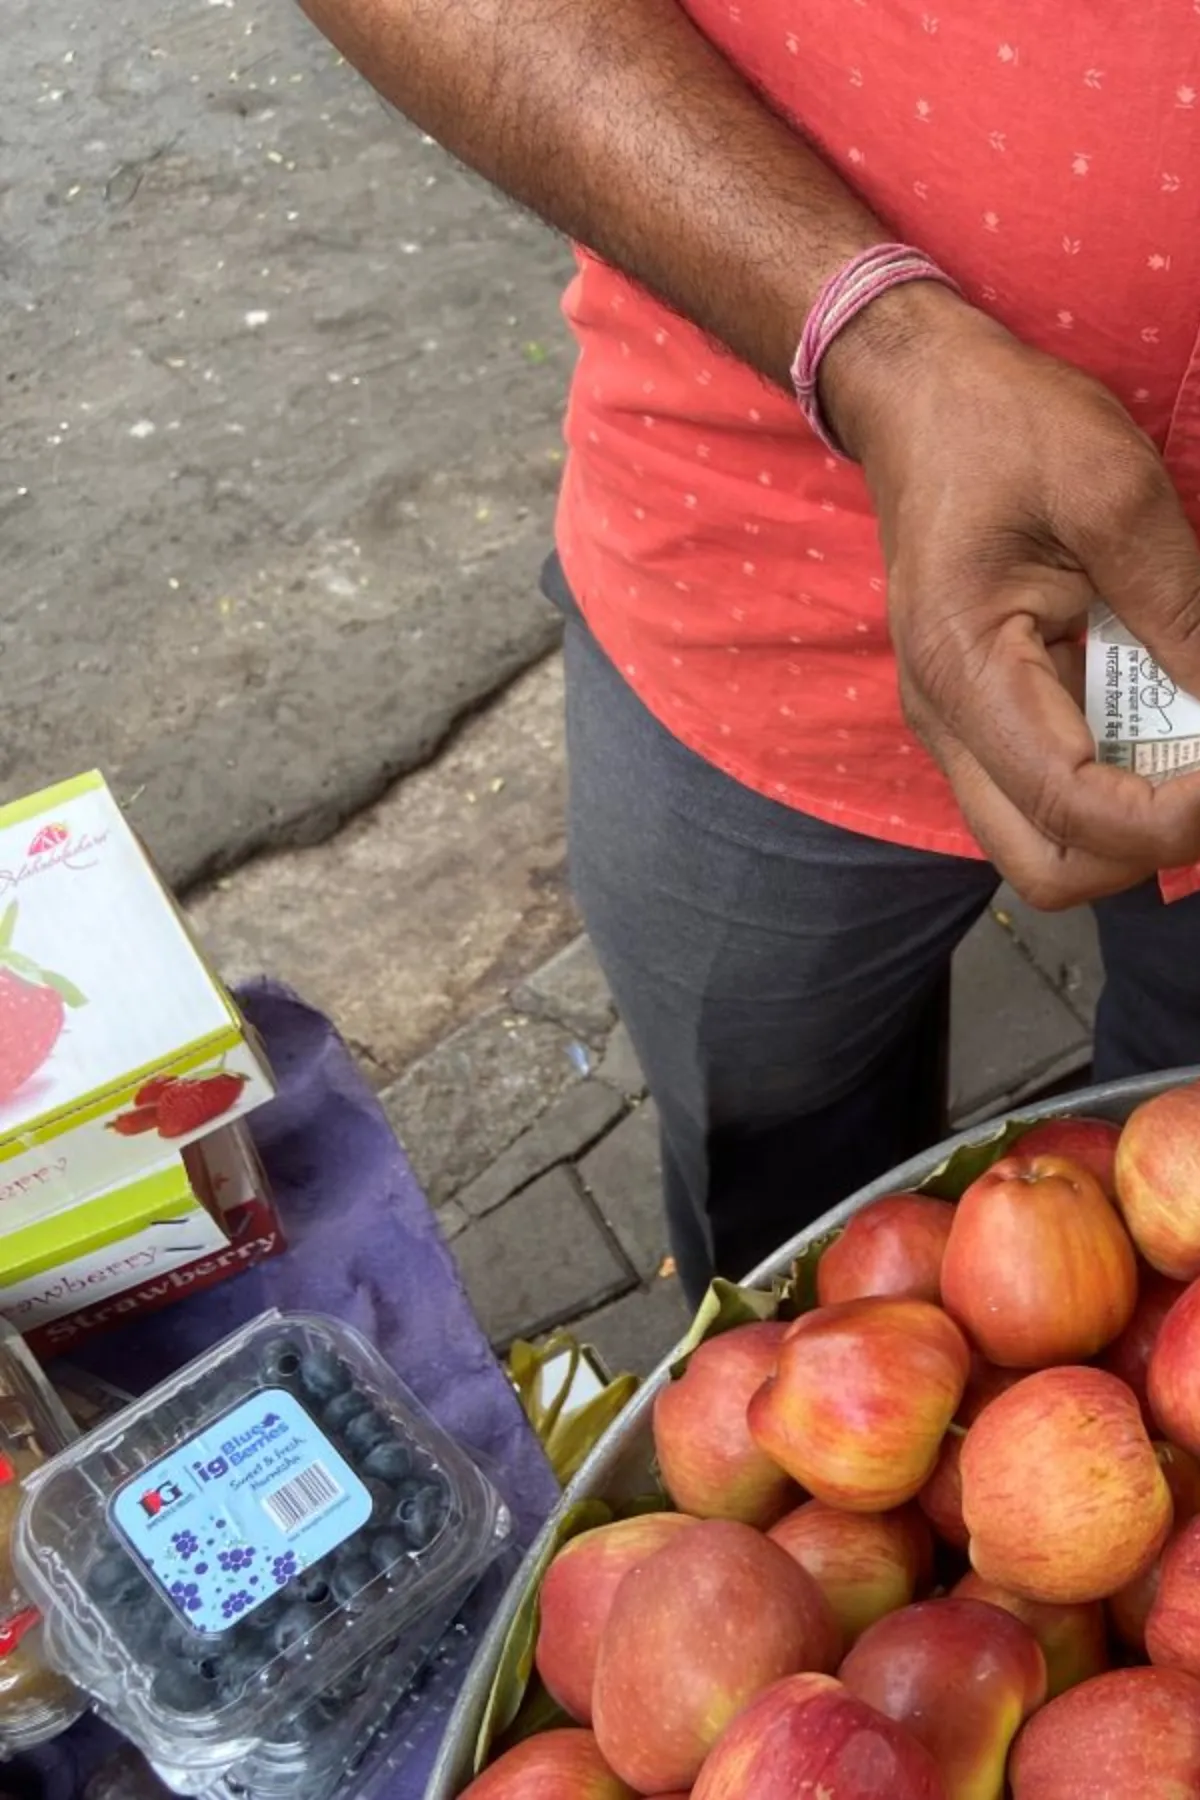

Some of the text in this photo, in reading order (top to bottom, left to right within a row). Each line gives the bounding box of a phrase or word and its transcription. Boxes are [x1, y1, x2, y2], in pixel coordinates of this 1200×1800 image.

[1105, 645, 1121, 687] भारतीय
[46, 1232, 276, 1343] Strawberry
[221, 1423, 266, 1455] Blue
[228, 1422, 290, 1466] Berries
